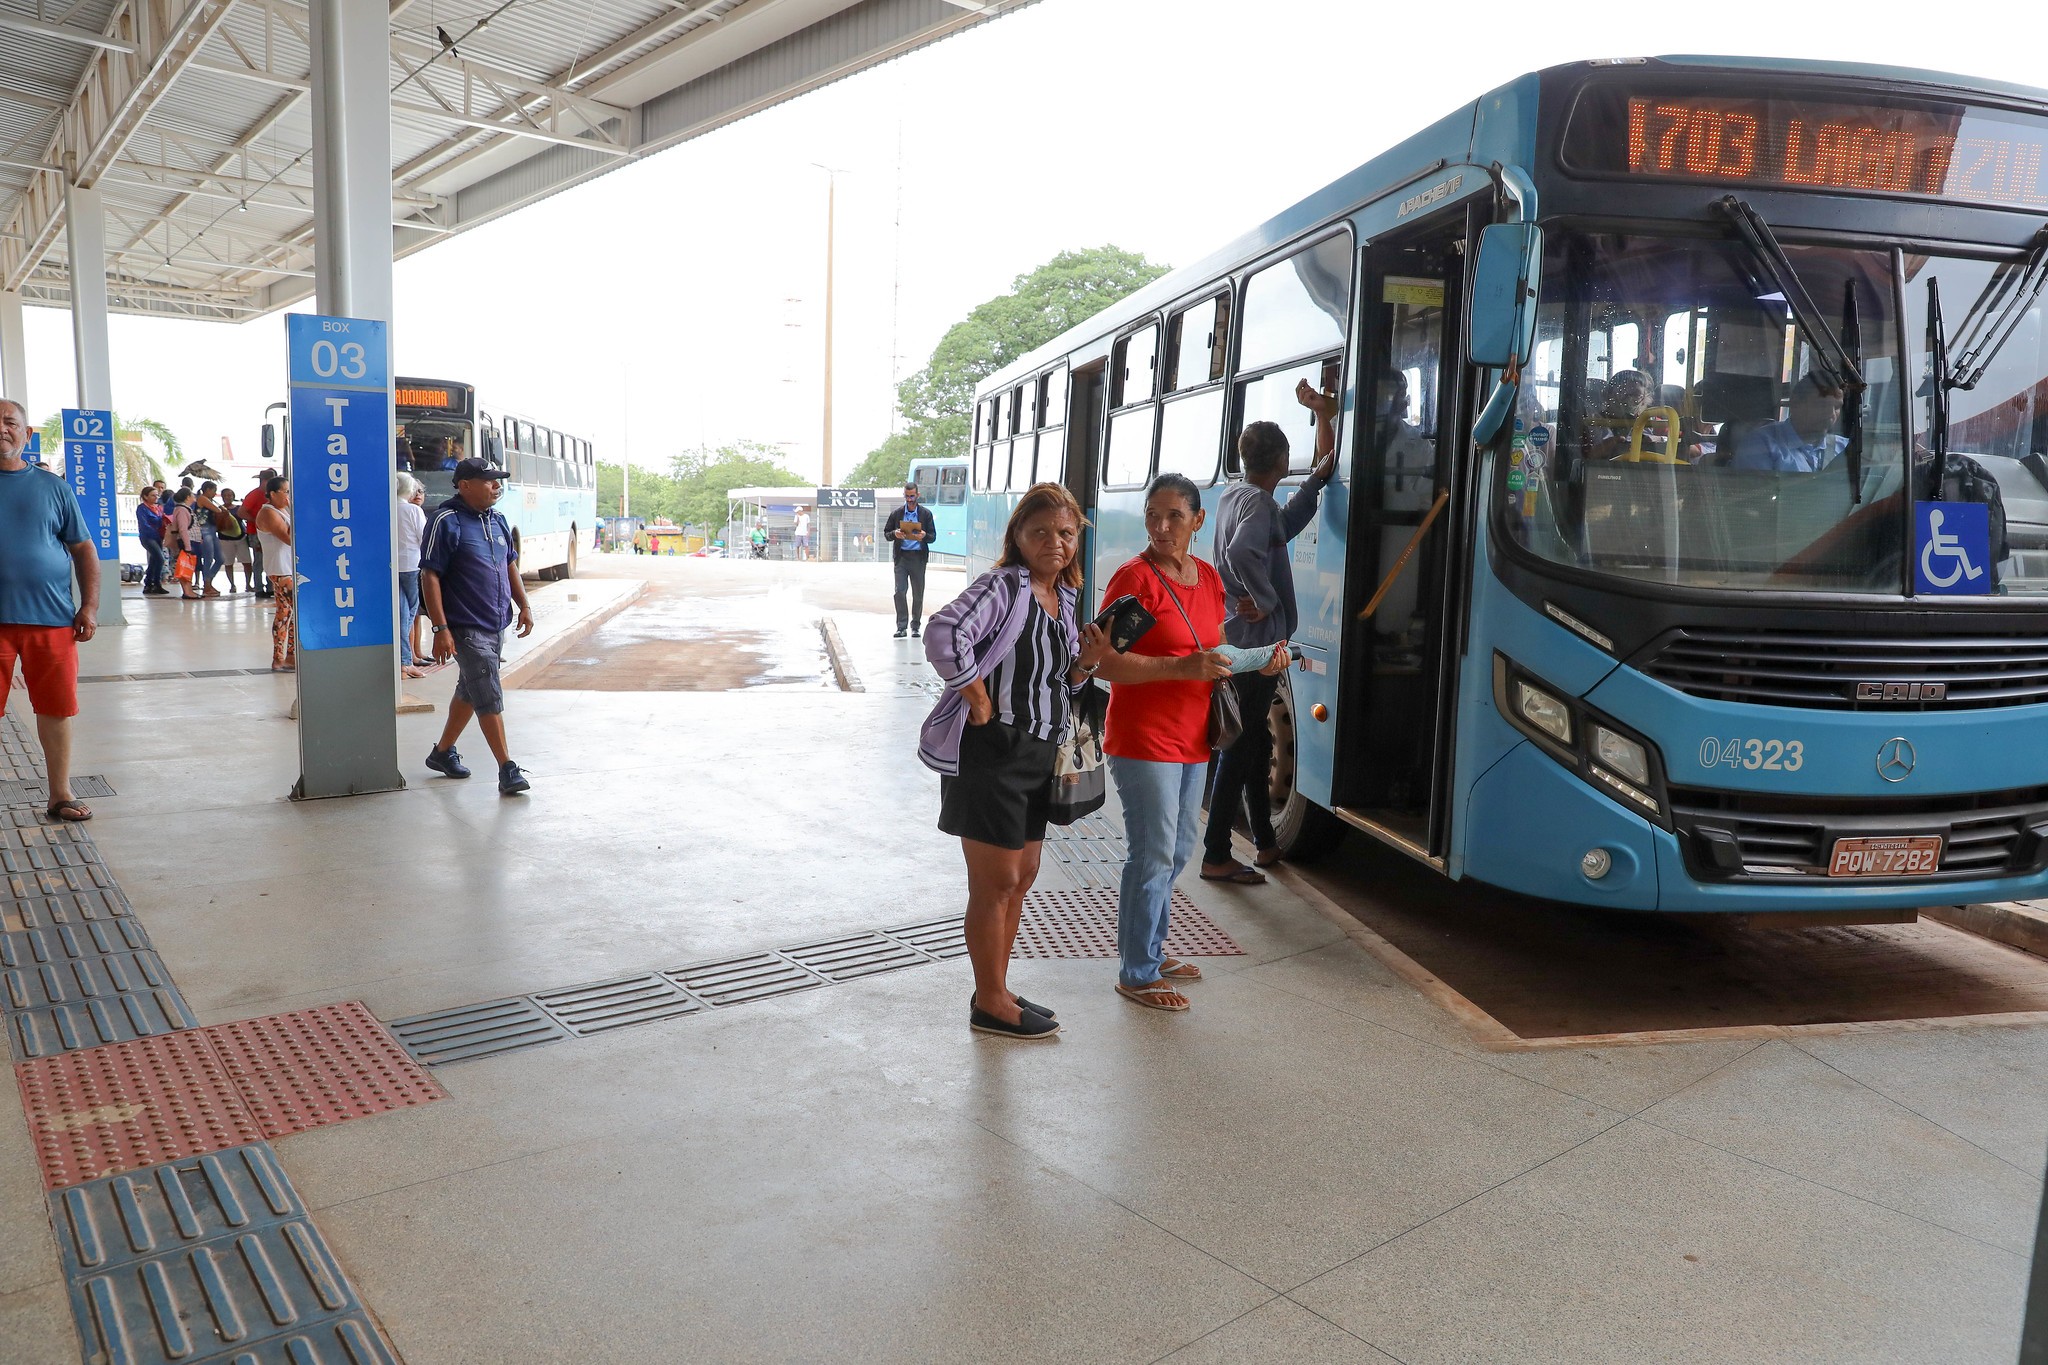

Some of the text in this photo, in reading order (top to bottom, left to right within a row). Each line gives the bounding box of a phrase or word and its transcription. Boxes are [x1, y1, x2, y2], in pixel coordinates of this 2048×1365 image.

[1783, 119, 1916, 192] LAGO
[1925, 134, 2048, 203] AZUL
[322, 321, 350, 333] BOX
[311, 340, 367, 379] 03
[73, 418, 104, 437] 02
[73, 444, 86, 496] STPCR
[830, 491, 860, 507] RG
[325, 397, 354, 637] Taguatur
[1308, 625, 1338, 644] ENTRADA
[1856, 682, 1946, 701] CAIO
[1699, 736, 1804, 772] 04323
